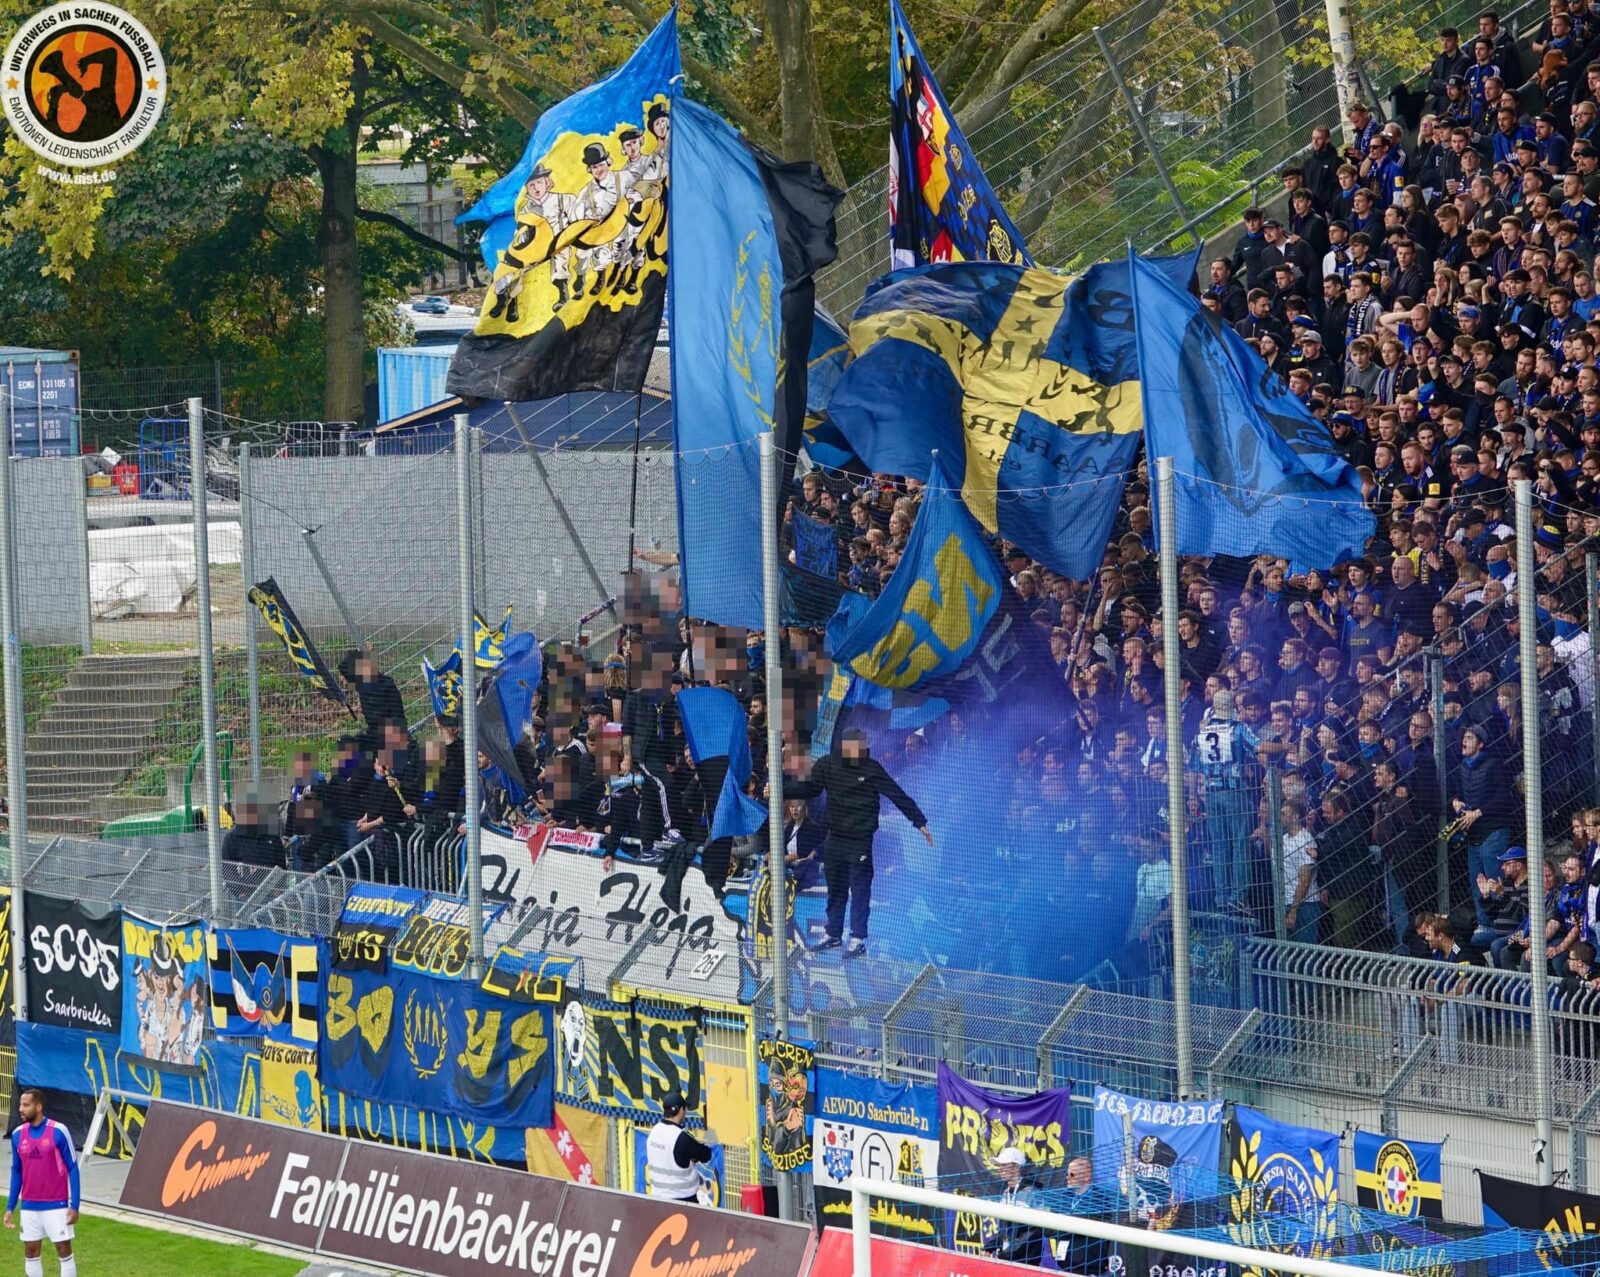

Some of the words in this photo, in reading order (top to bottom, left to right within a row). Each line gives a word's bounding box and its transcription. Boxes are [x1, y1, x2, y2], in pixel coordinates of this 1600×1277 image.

[1205, 732, 1221, 763] 3
[29, 924, 120, 991] SC95
[694, 952, 717, 975] 26
[43, 988, 113, 1028] Saarbrücken
[822, 1096, 866, 1119] AEWDO
[1131, 1101, 1223, 1127] FREUNDE
[269, 1151, 622, 1277] Familienbäckerei
